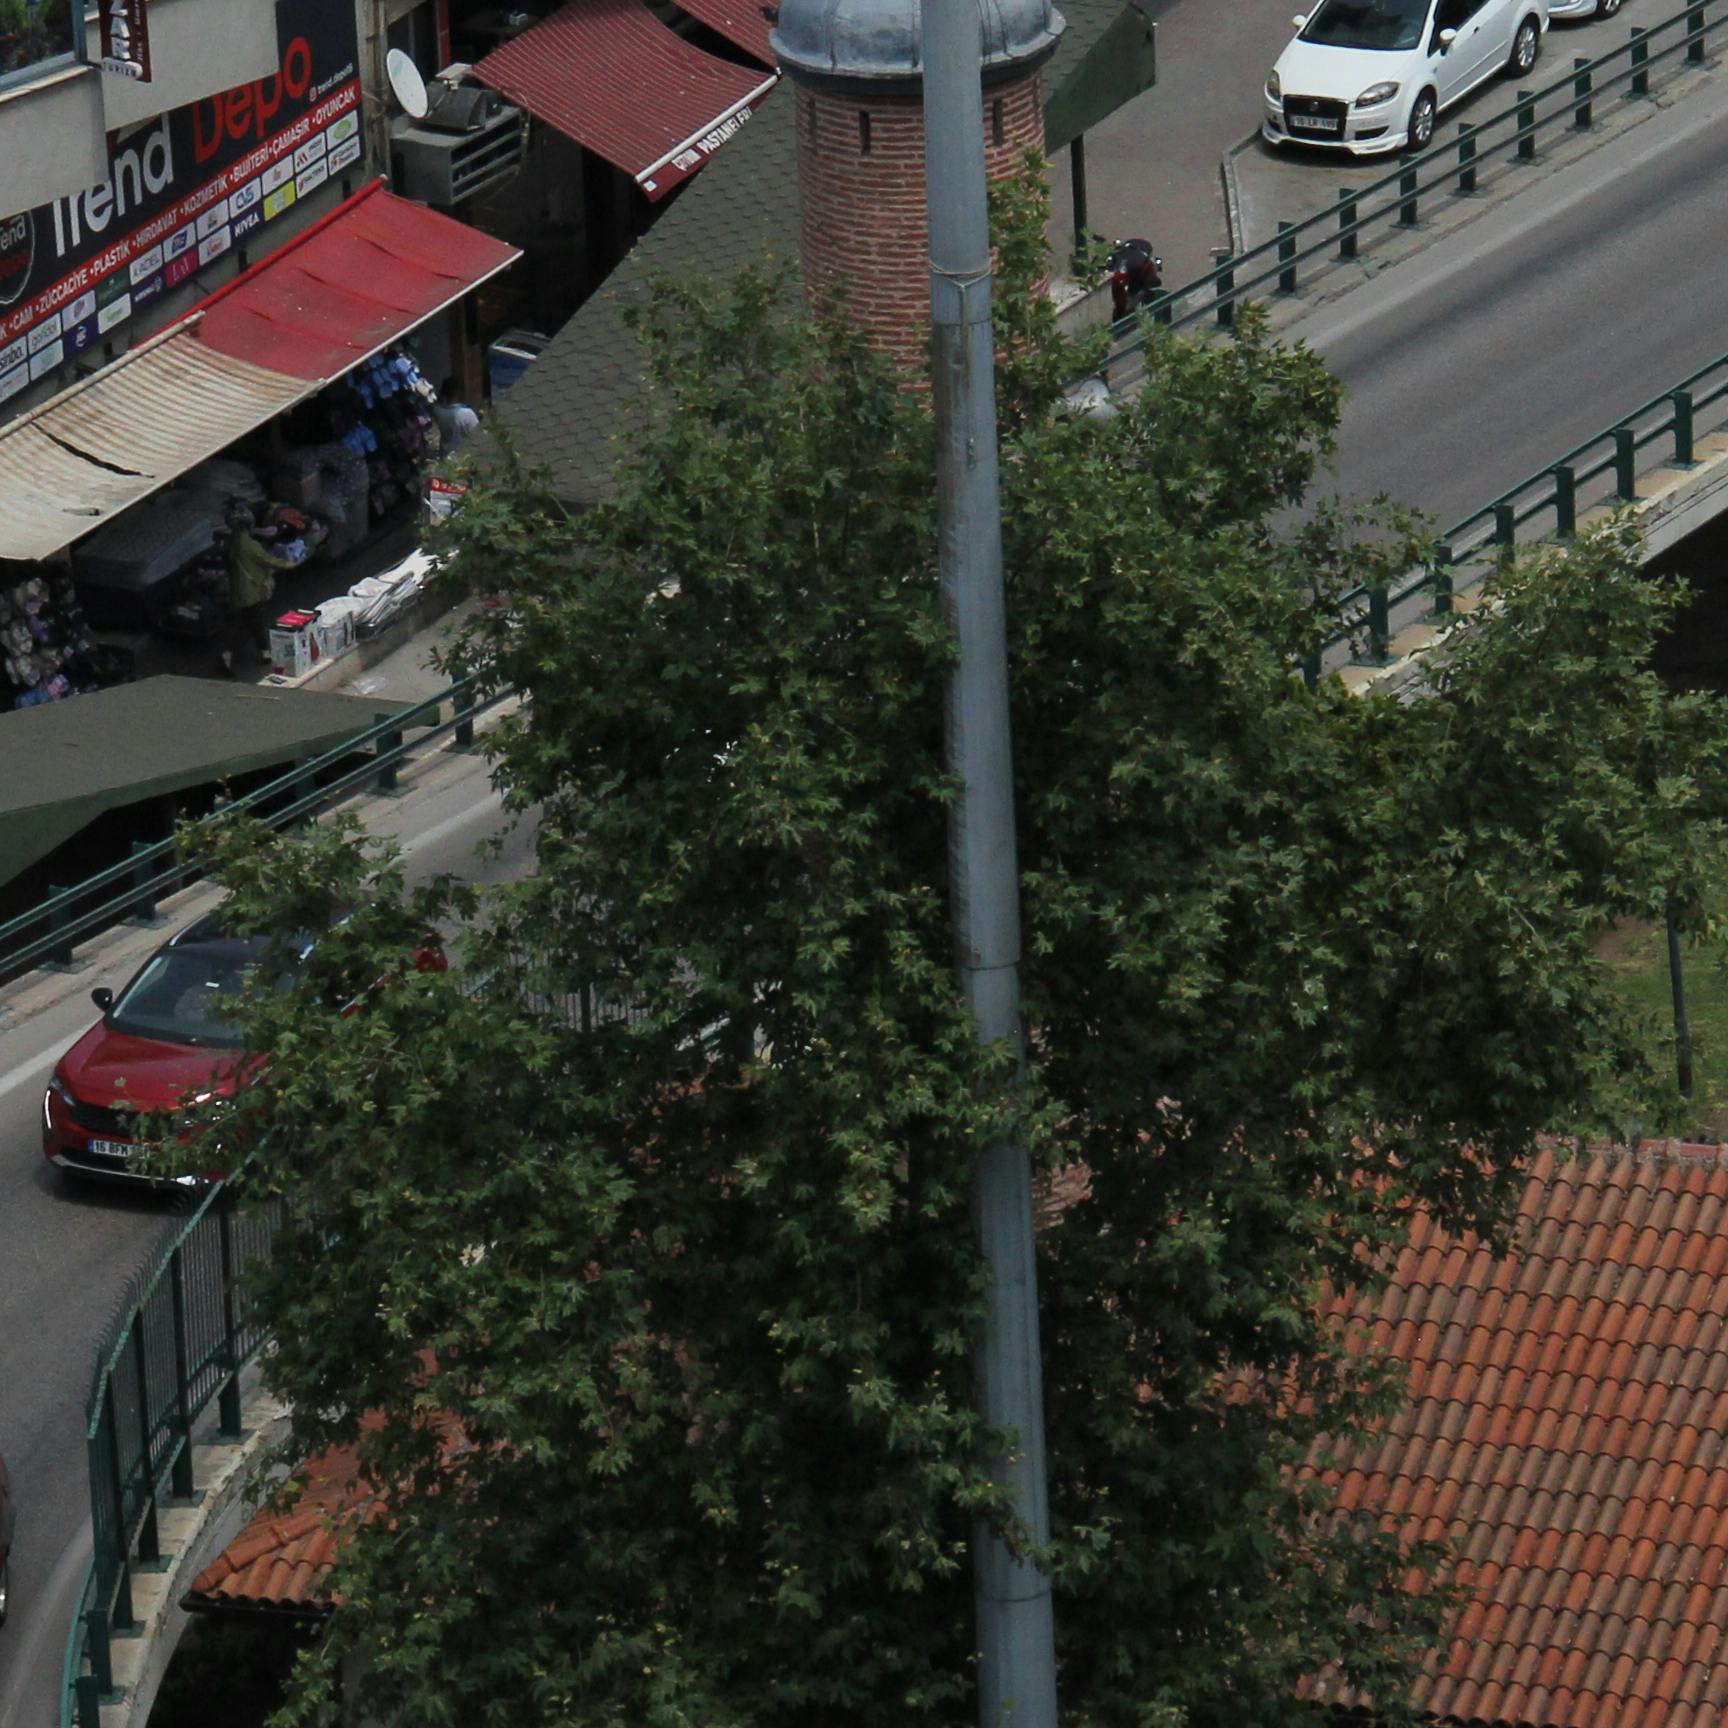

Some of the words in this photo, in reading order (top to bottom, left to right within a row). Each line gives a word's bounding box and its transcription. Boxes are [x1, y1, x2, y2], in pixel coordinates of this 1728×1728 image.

[12, 304, 34, 331] CAM
[94, 240, 131, 276] PLASTİK
[135, 208, 178, 248] HIRDAVAT
[316, 84, 357, 125] OYUNCAK
